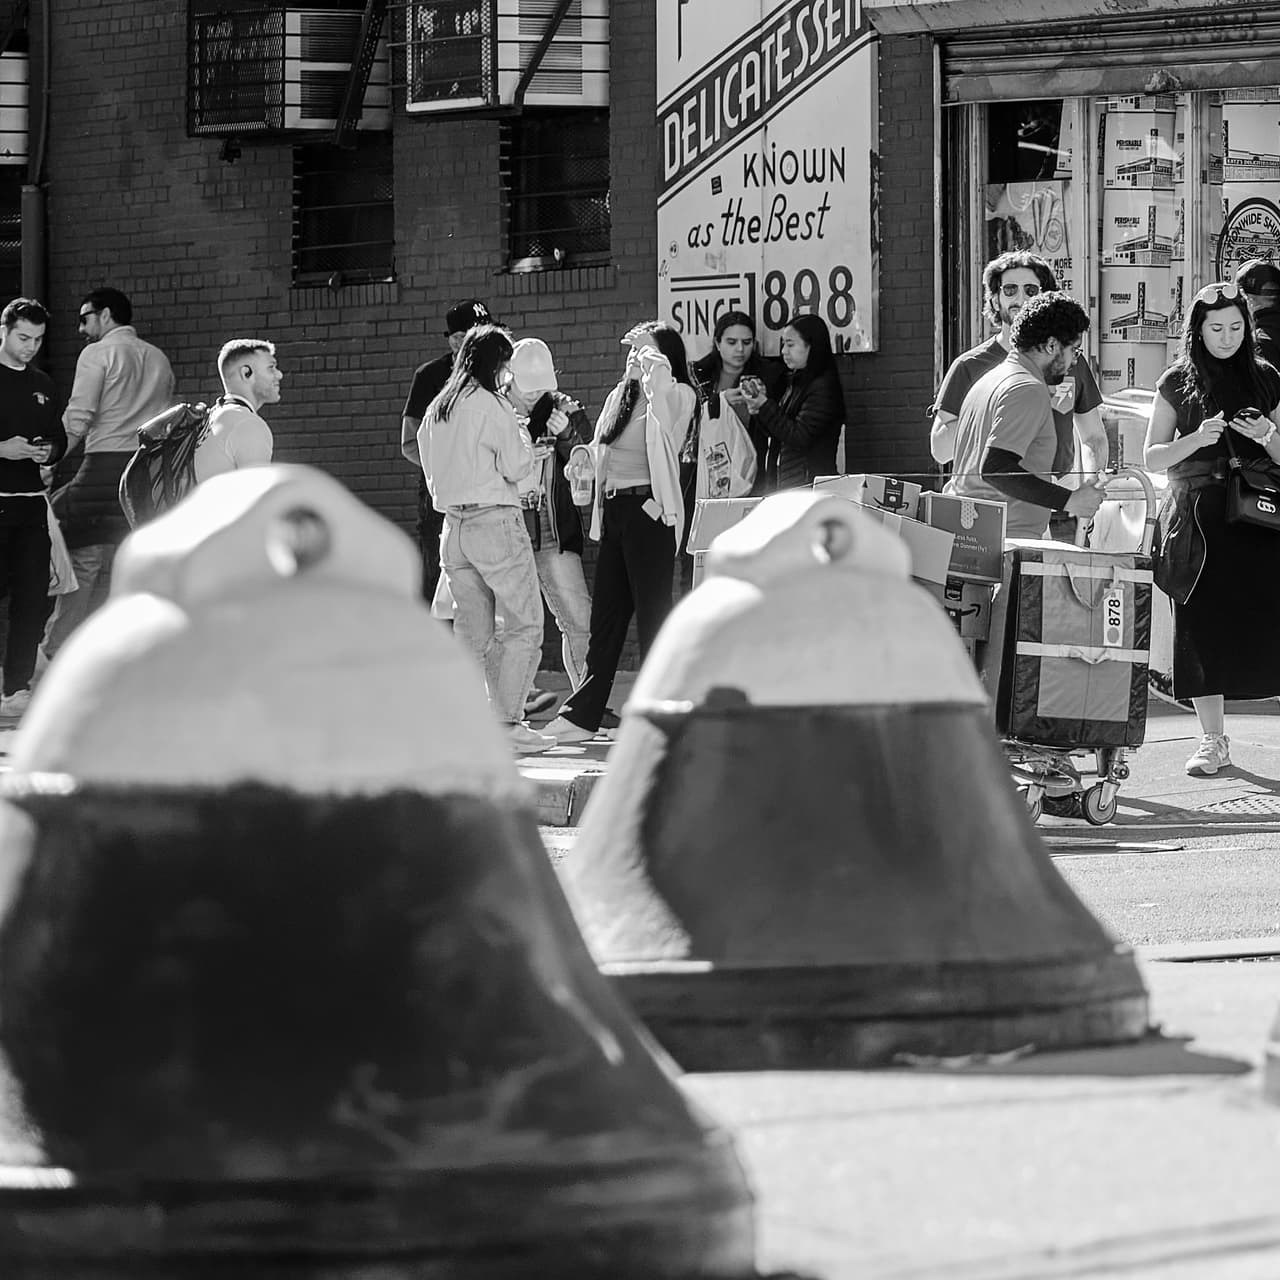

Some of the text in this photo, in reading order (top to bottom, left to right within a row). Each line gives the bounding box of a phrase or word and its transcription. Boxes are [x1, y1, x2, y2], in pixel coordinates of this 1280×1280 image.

[743, 141, 846, 188] KNOWN
[687, 192, 832, 249] as the Best
[1224, 212, 1263, 269] NATIONWIDE
[1108, 599, 1121, 626] 878
